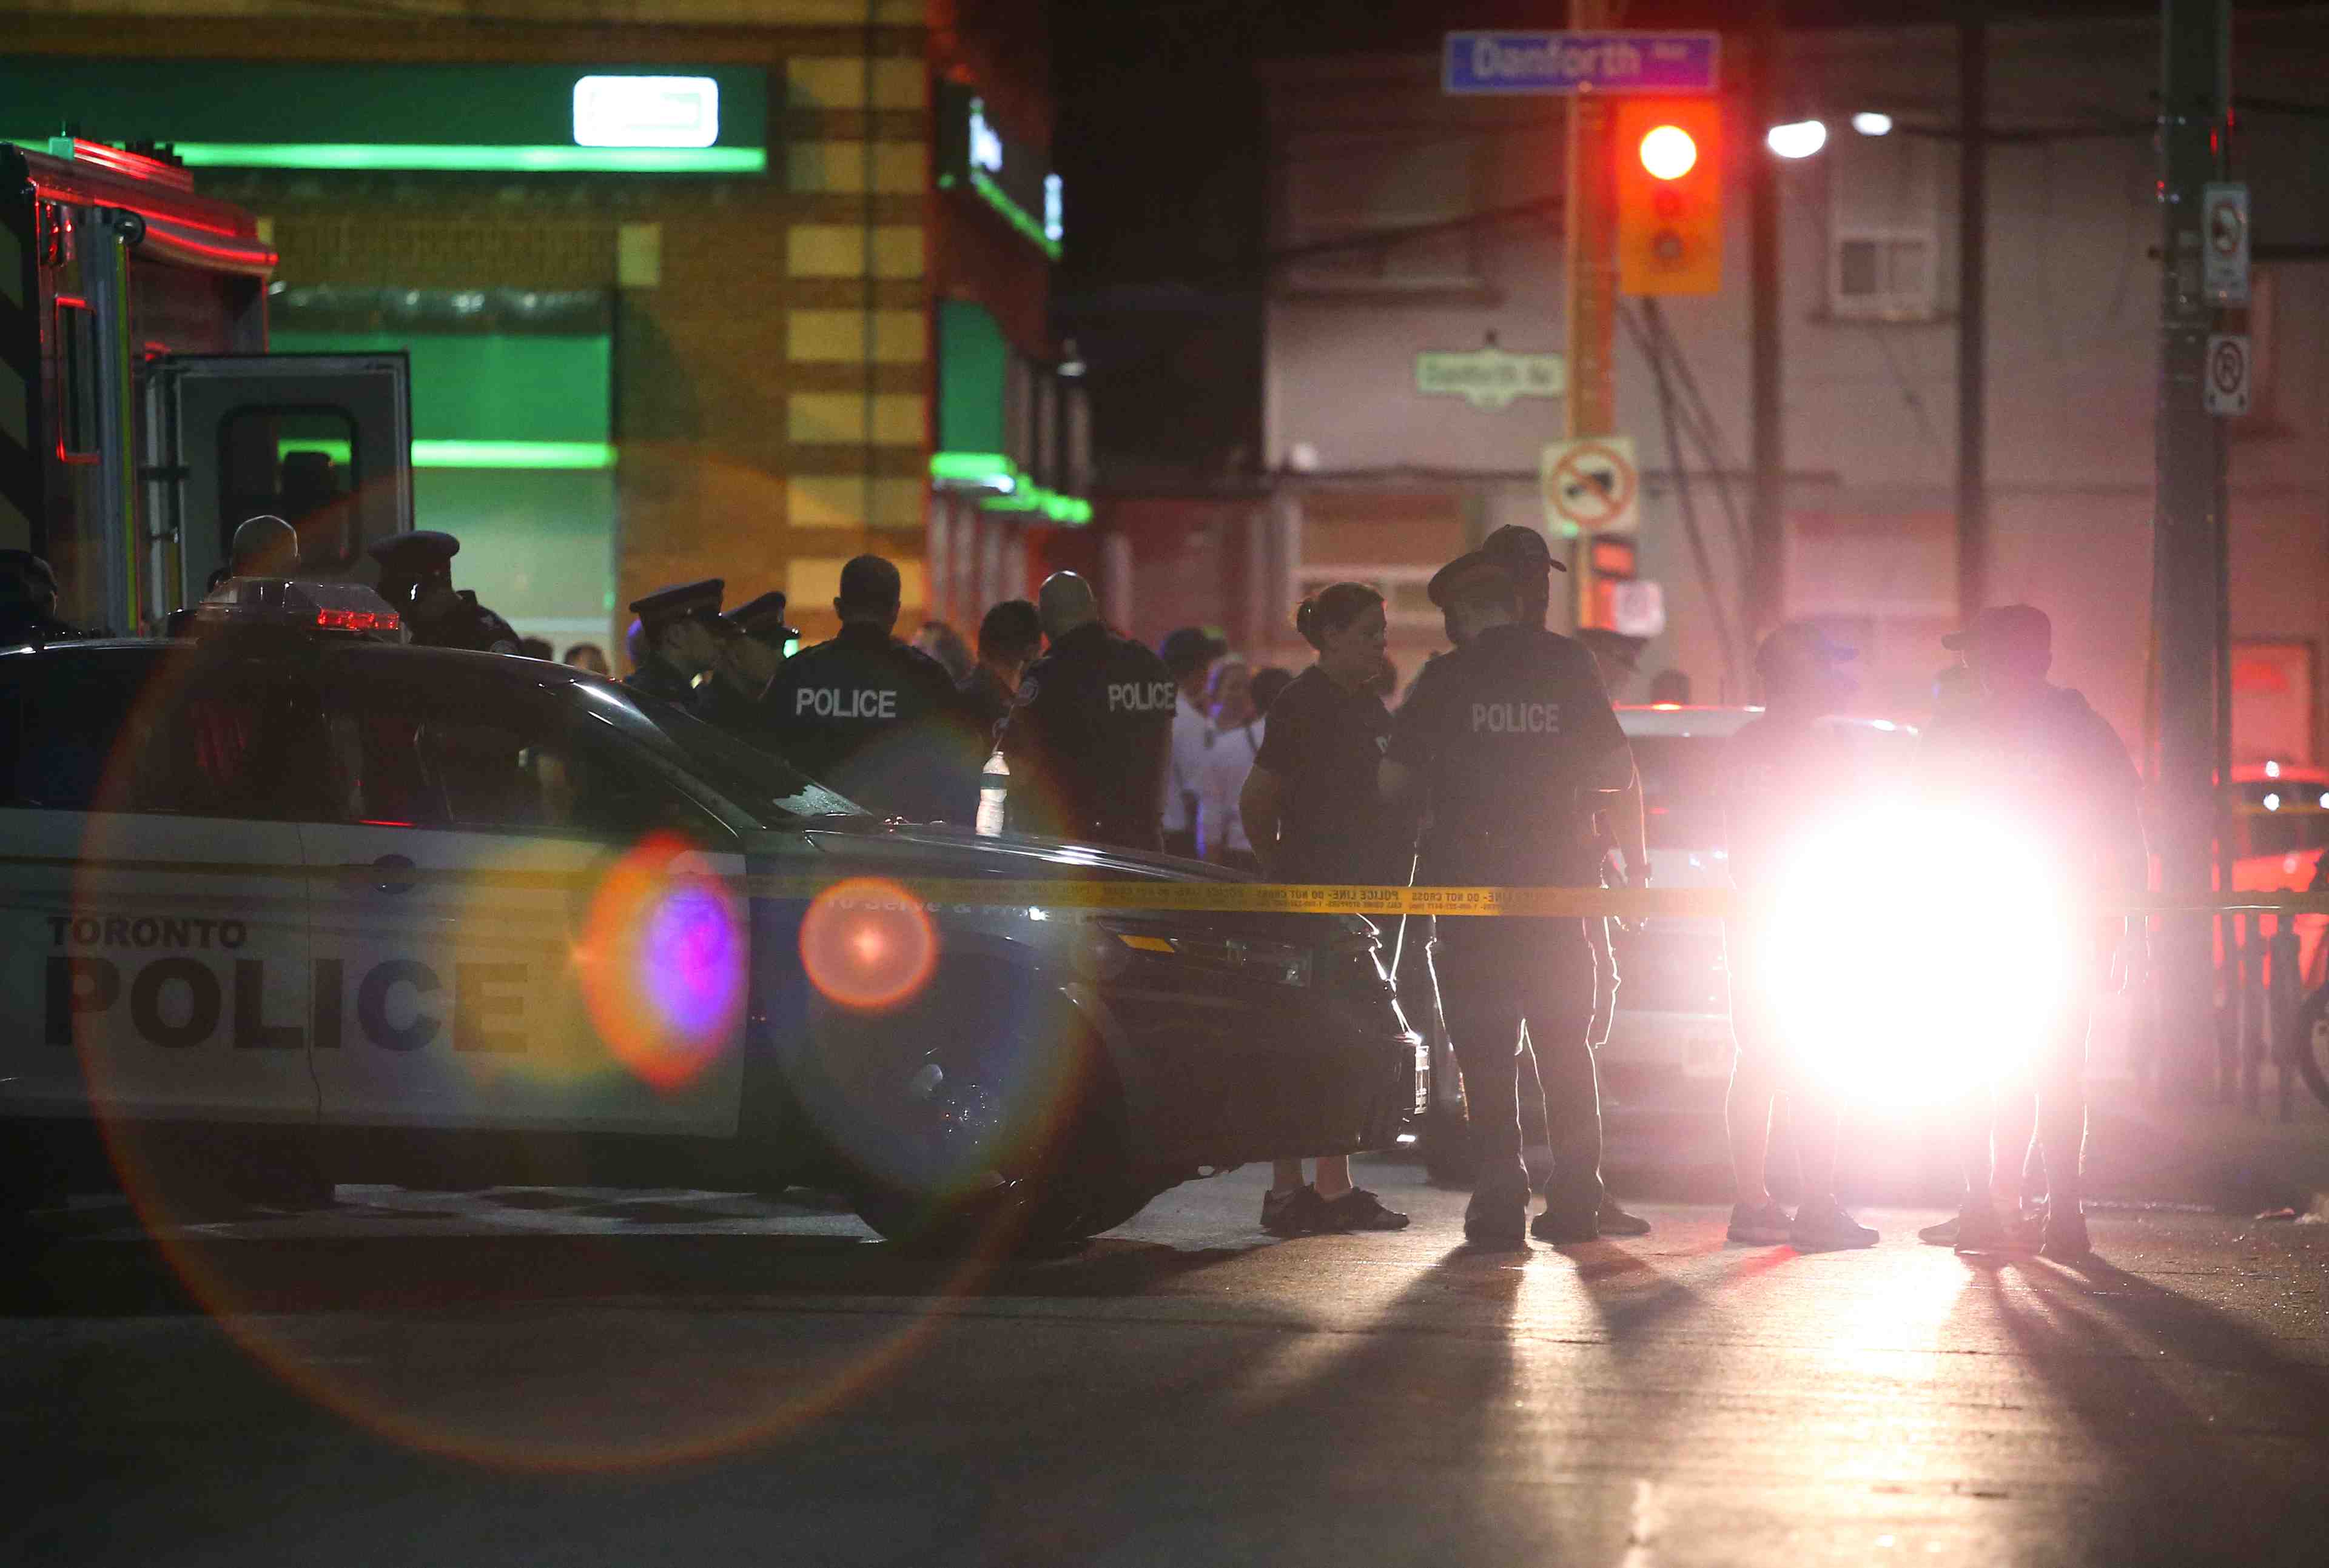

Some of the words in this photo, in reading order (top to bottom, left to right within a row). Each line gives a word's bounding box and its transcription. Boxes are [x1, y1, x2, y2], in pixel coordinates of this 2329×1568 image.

[1474, 38, 1641, 78] Danforth
[796, 688, 896, 718] POLICE
[1107, 682, 1177, 711] POLICE
[1471, 703, 1559, 733] POLICE
[47, 916, 247, 949] TORONTO
[45, 956, 528, 1053] POLICE
